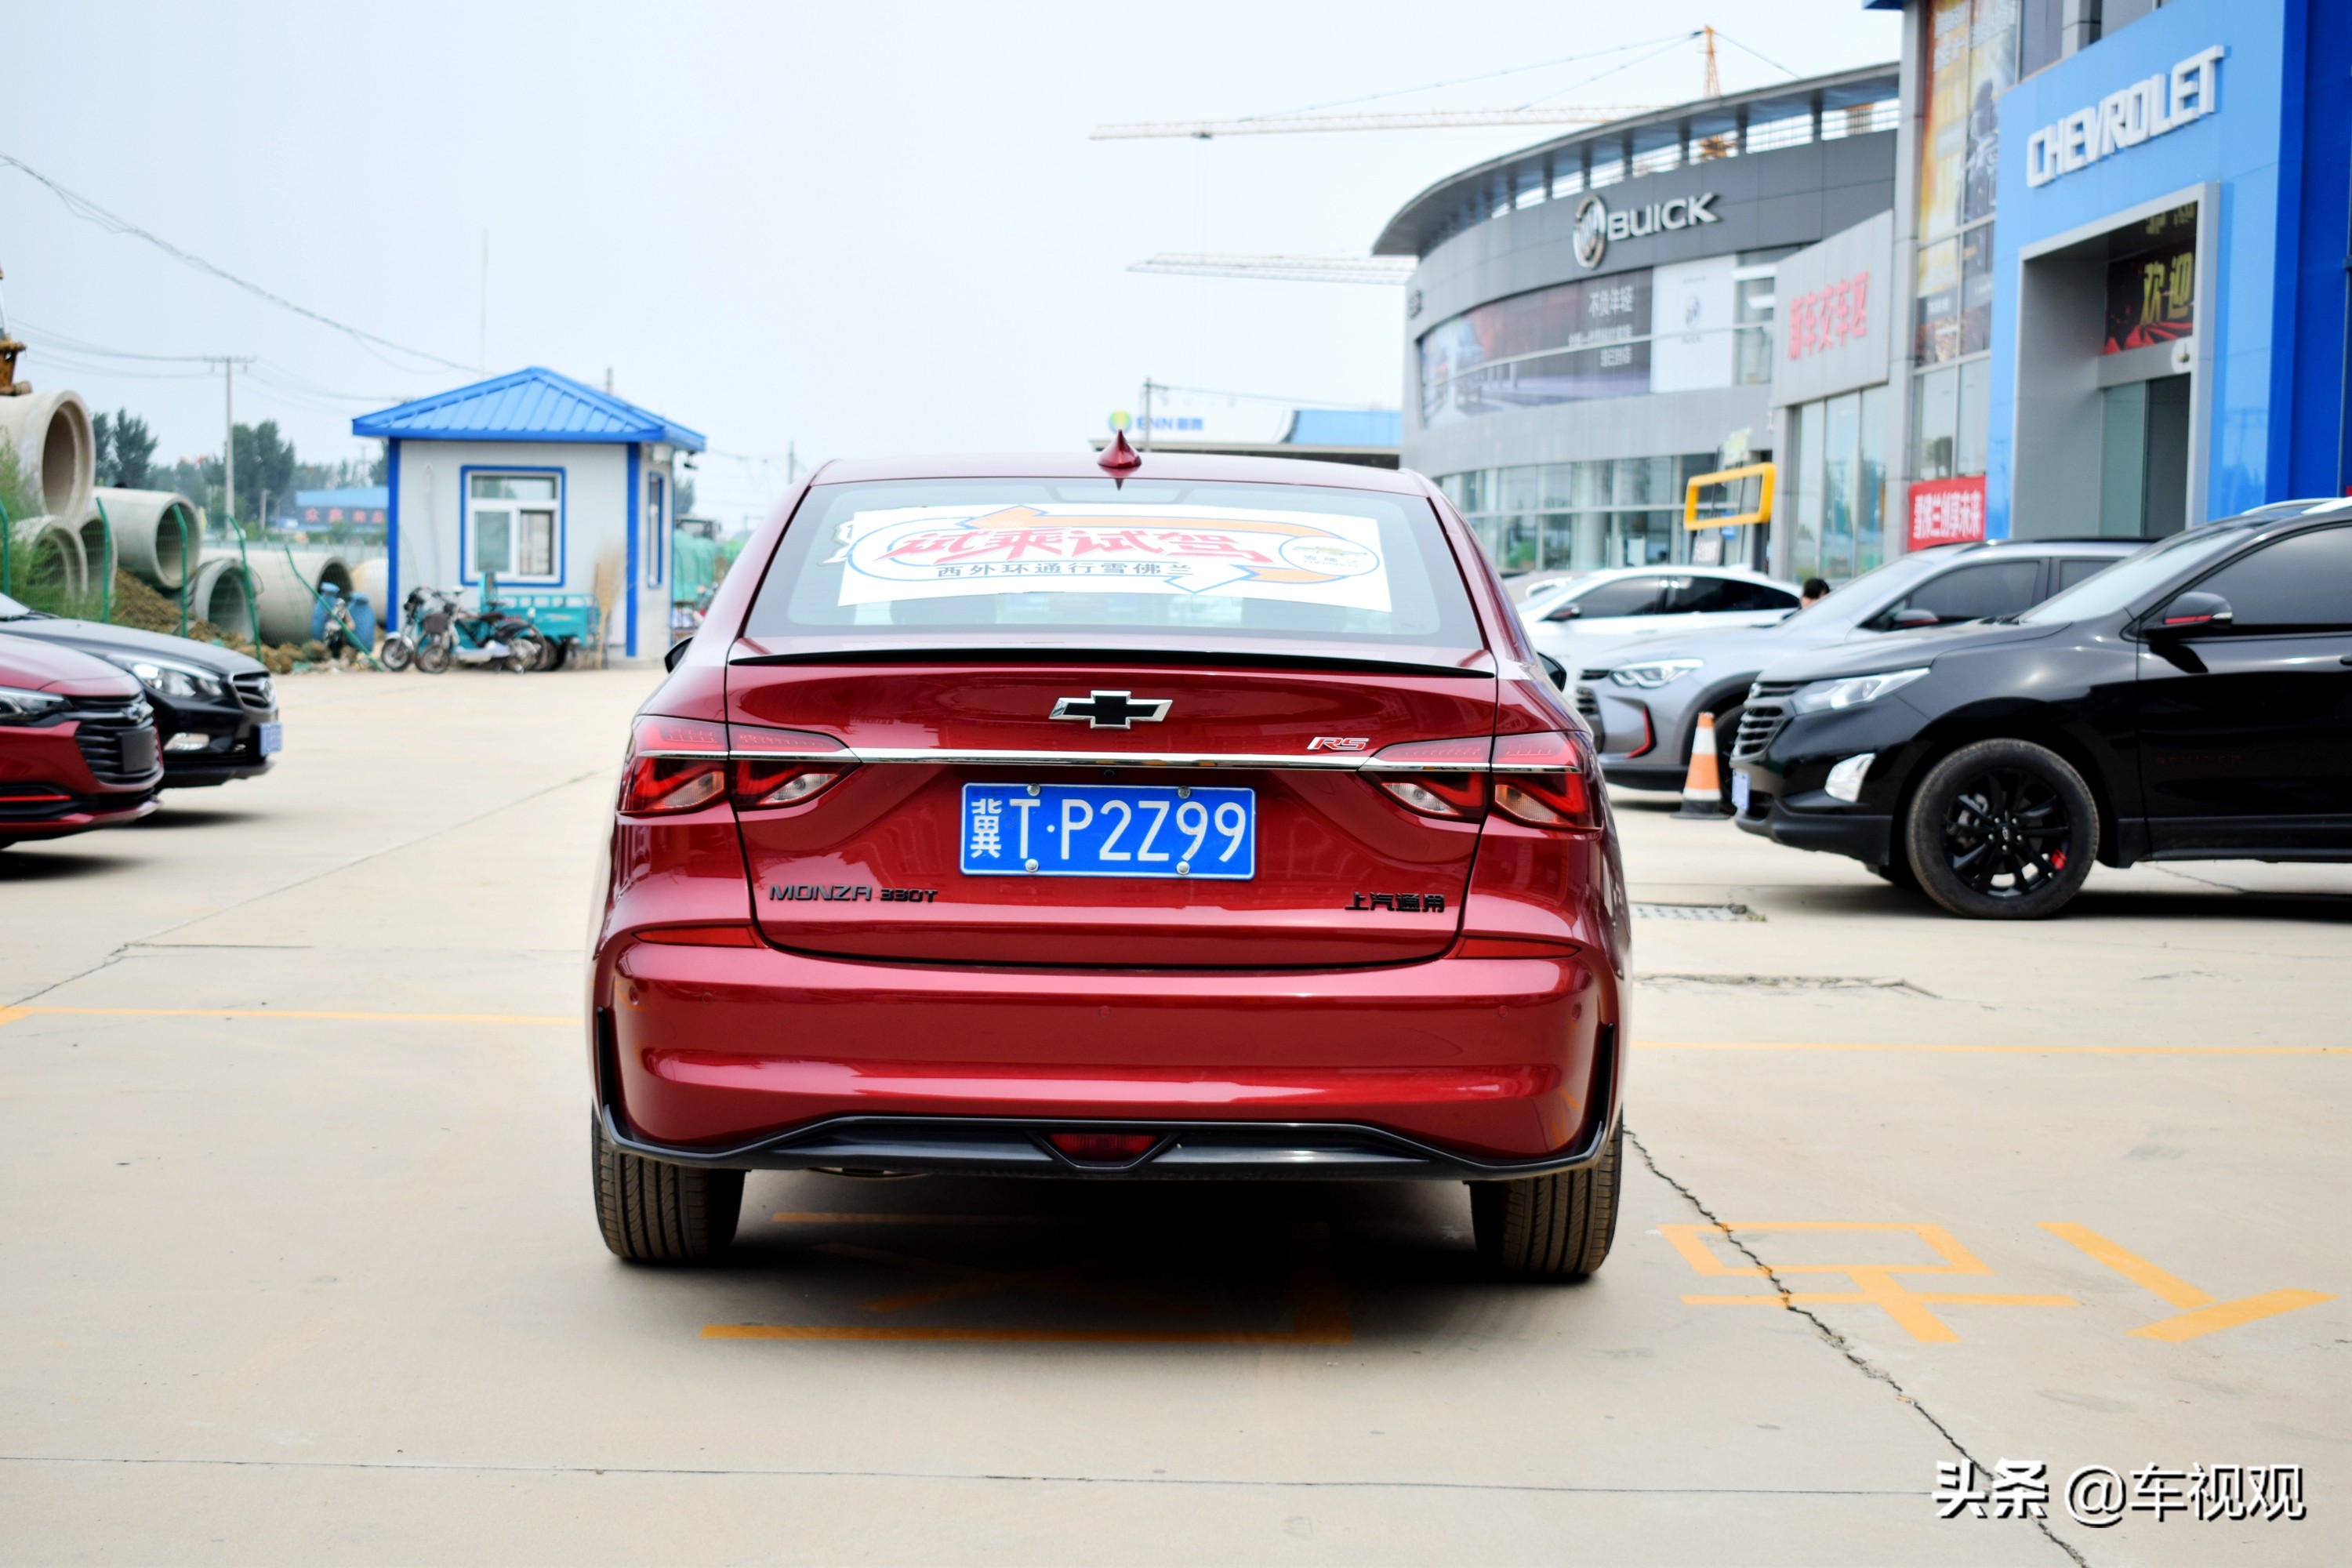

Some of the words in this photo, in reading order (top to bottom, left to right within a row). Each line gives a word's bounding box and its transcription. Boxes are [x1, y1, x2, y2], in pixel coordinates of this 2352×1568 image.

[2026, 44, 2225, 189] CHEVROLET
[1607, 192, 1719, 241] BUICK
[2140, 252, 2193, 326] 欢迎
[1788, 271, 1869, 361] 新车交车区
[873, 527, 1276, 564] 试乘试驾
[935, 563, 1194, 578] 西外环通行雪佛兰
[1307, 737, 1370, 751] RS
[769, 884, 872, 902] MONZA
[880, 888, 938, 903] 330T
[1345, 891, 1446, 913] 上汽通用
